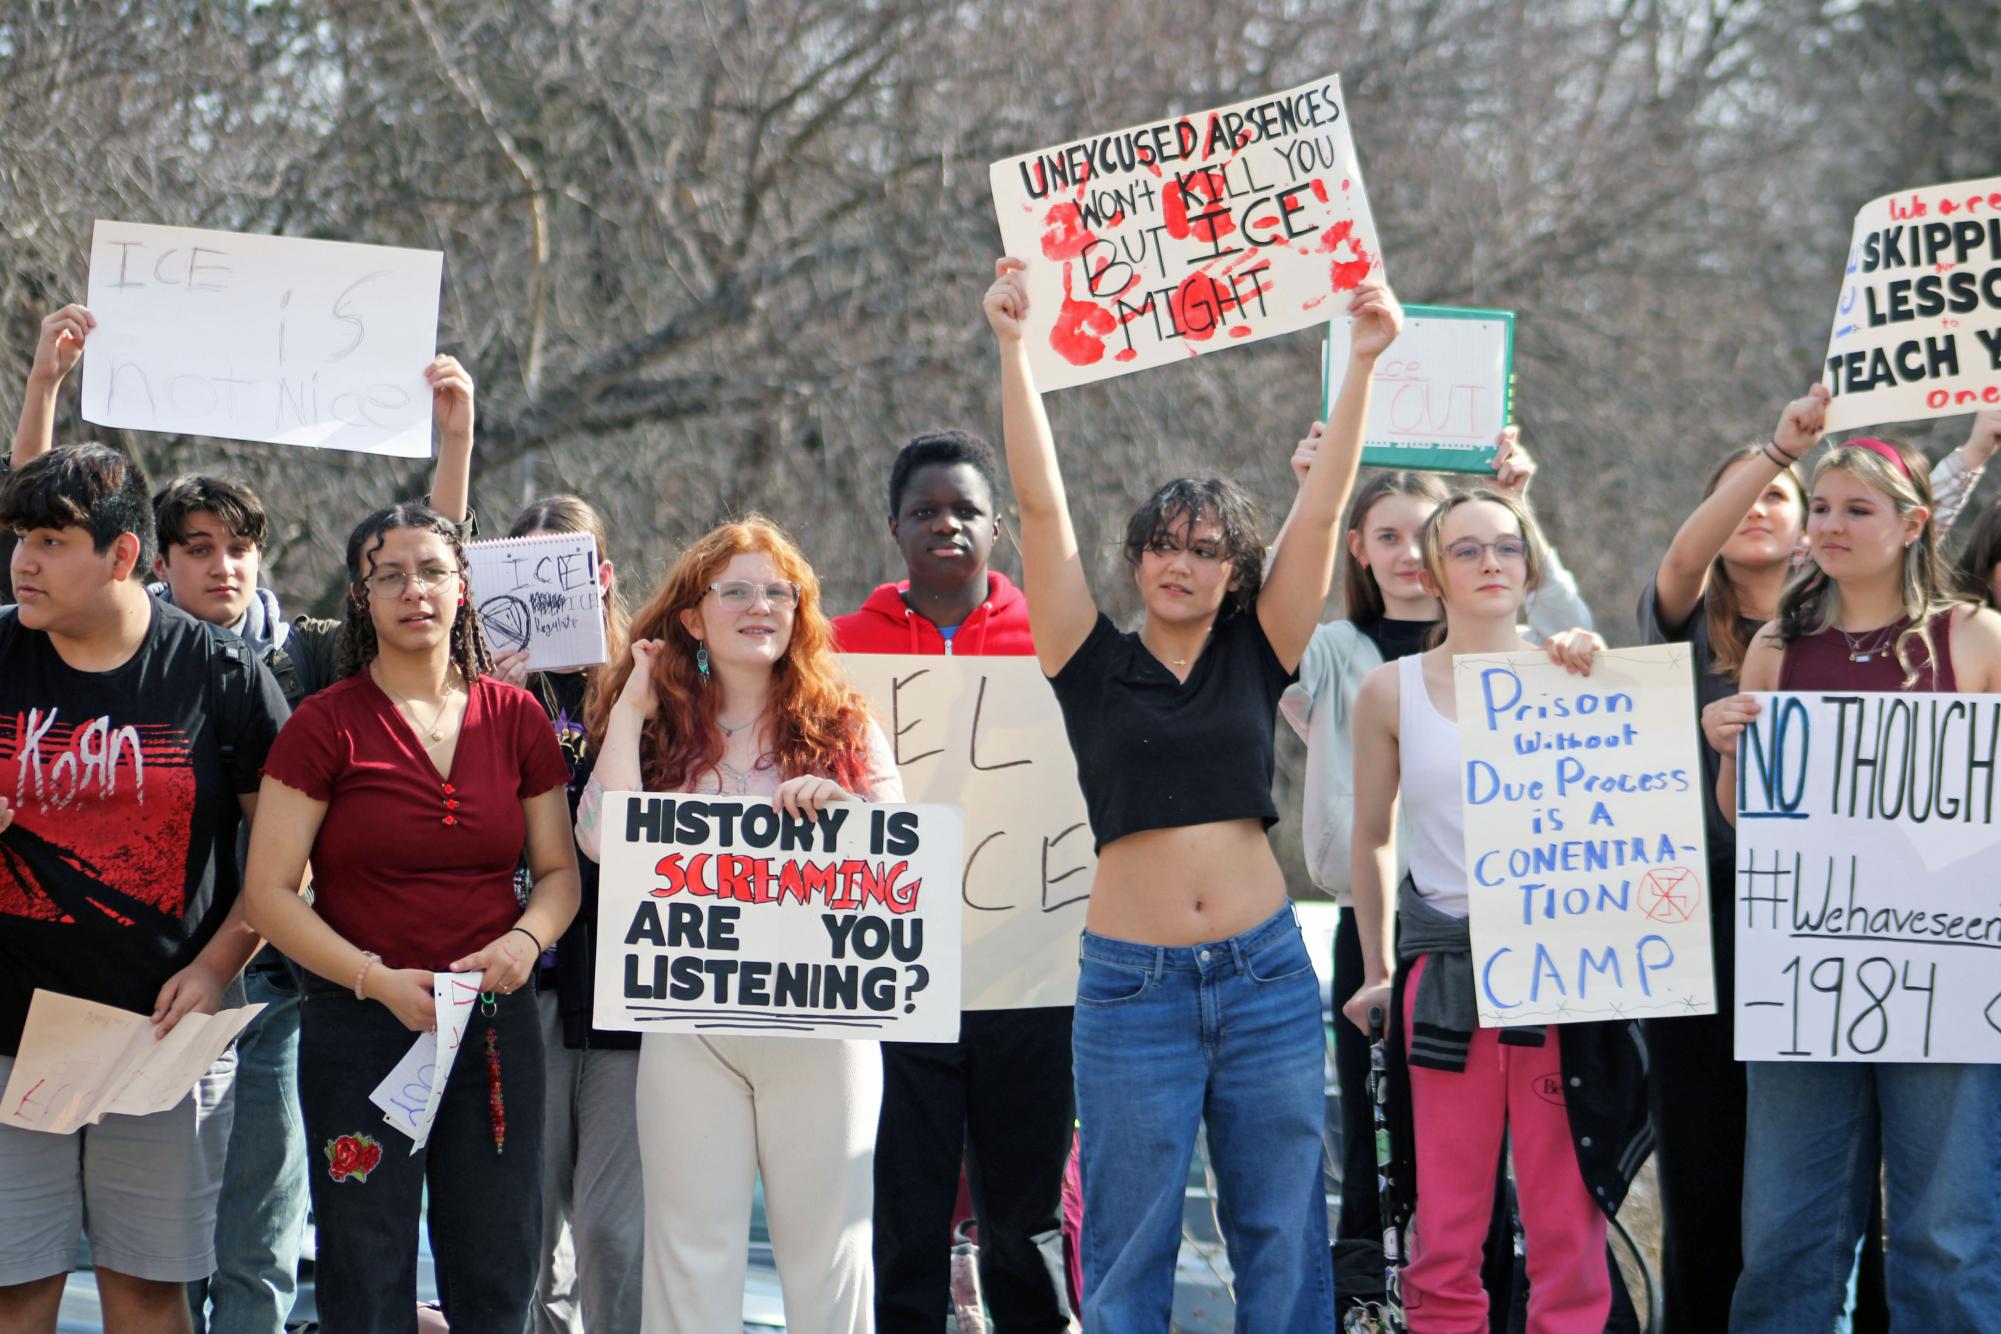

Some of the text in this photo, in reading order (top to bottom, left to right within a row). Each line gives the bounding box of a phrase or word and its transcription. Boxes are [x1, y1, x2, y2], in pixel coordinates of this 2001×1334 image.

[1019, 84, 1340, 201] UNEXCUSED ABSENCES
[1175, 157, 1261, 211] KILL
[1274, 135, 1336, 184] YOU
[107, 241, 232, 293] ICE
[1081, 183, 1319, 297] BUT ICE
[1117, 267, 1271, 350] MIGHT
[1827, 334, 1959, 398] TEACH
[1391, 384, 1487, 435] OUT
[1481, 668, 1633, 731] Prison
[1467, 757, 1689, 805] Due Process
[1738, 695, 2001, 824] NO THOUGH
[625, 797, 920, 856] HISTORY IS
[1589, 801, 1615, 826] A
[648, 852, 923, 914] SCREAMING
[1474, 833, 1697, 887] CONENTRA-
[624, 901, 923, 962] ARE YOU
[1519, 880, 1631, 925] TION
[624, 954, 930, 1014] LISTENING?
